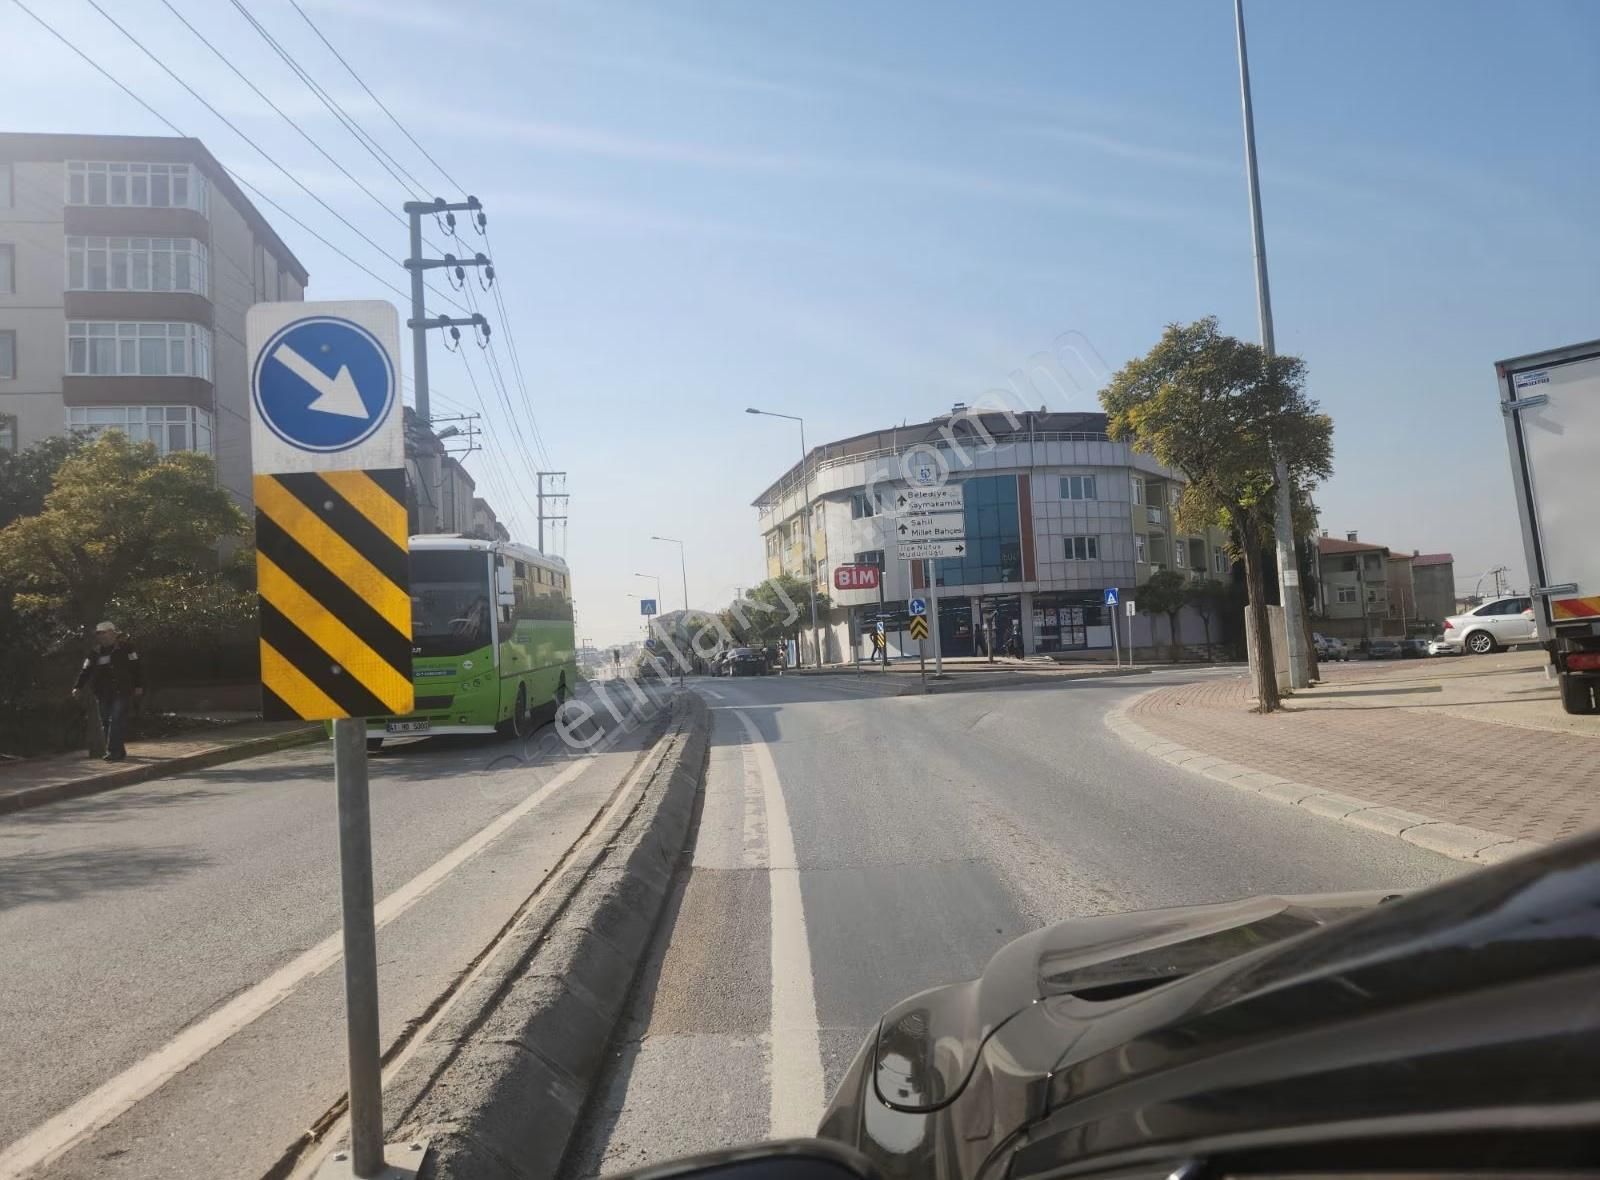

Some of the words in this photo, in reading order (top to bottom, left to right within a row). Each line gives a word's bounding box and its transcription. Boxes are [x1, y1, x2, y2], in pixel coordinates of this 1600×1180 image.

[907, 491, 947, 499] Belediye
[911, 519, 933, 527] Sahil
[911, 528, 932, 537] Millet
